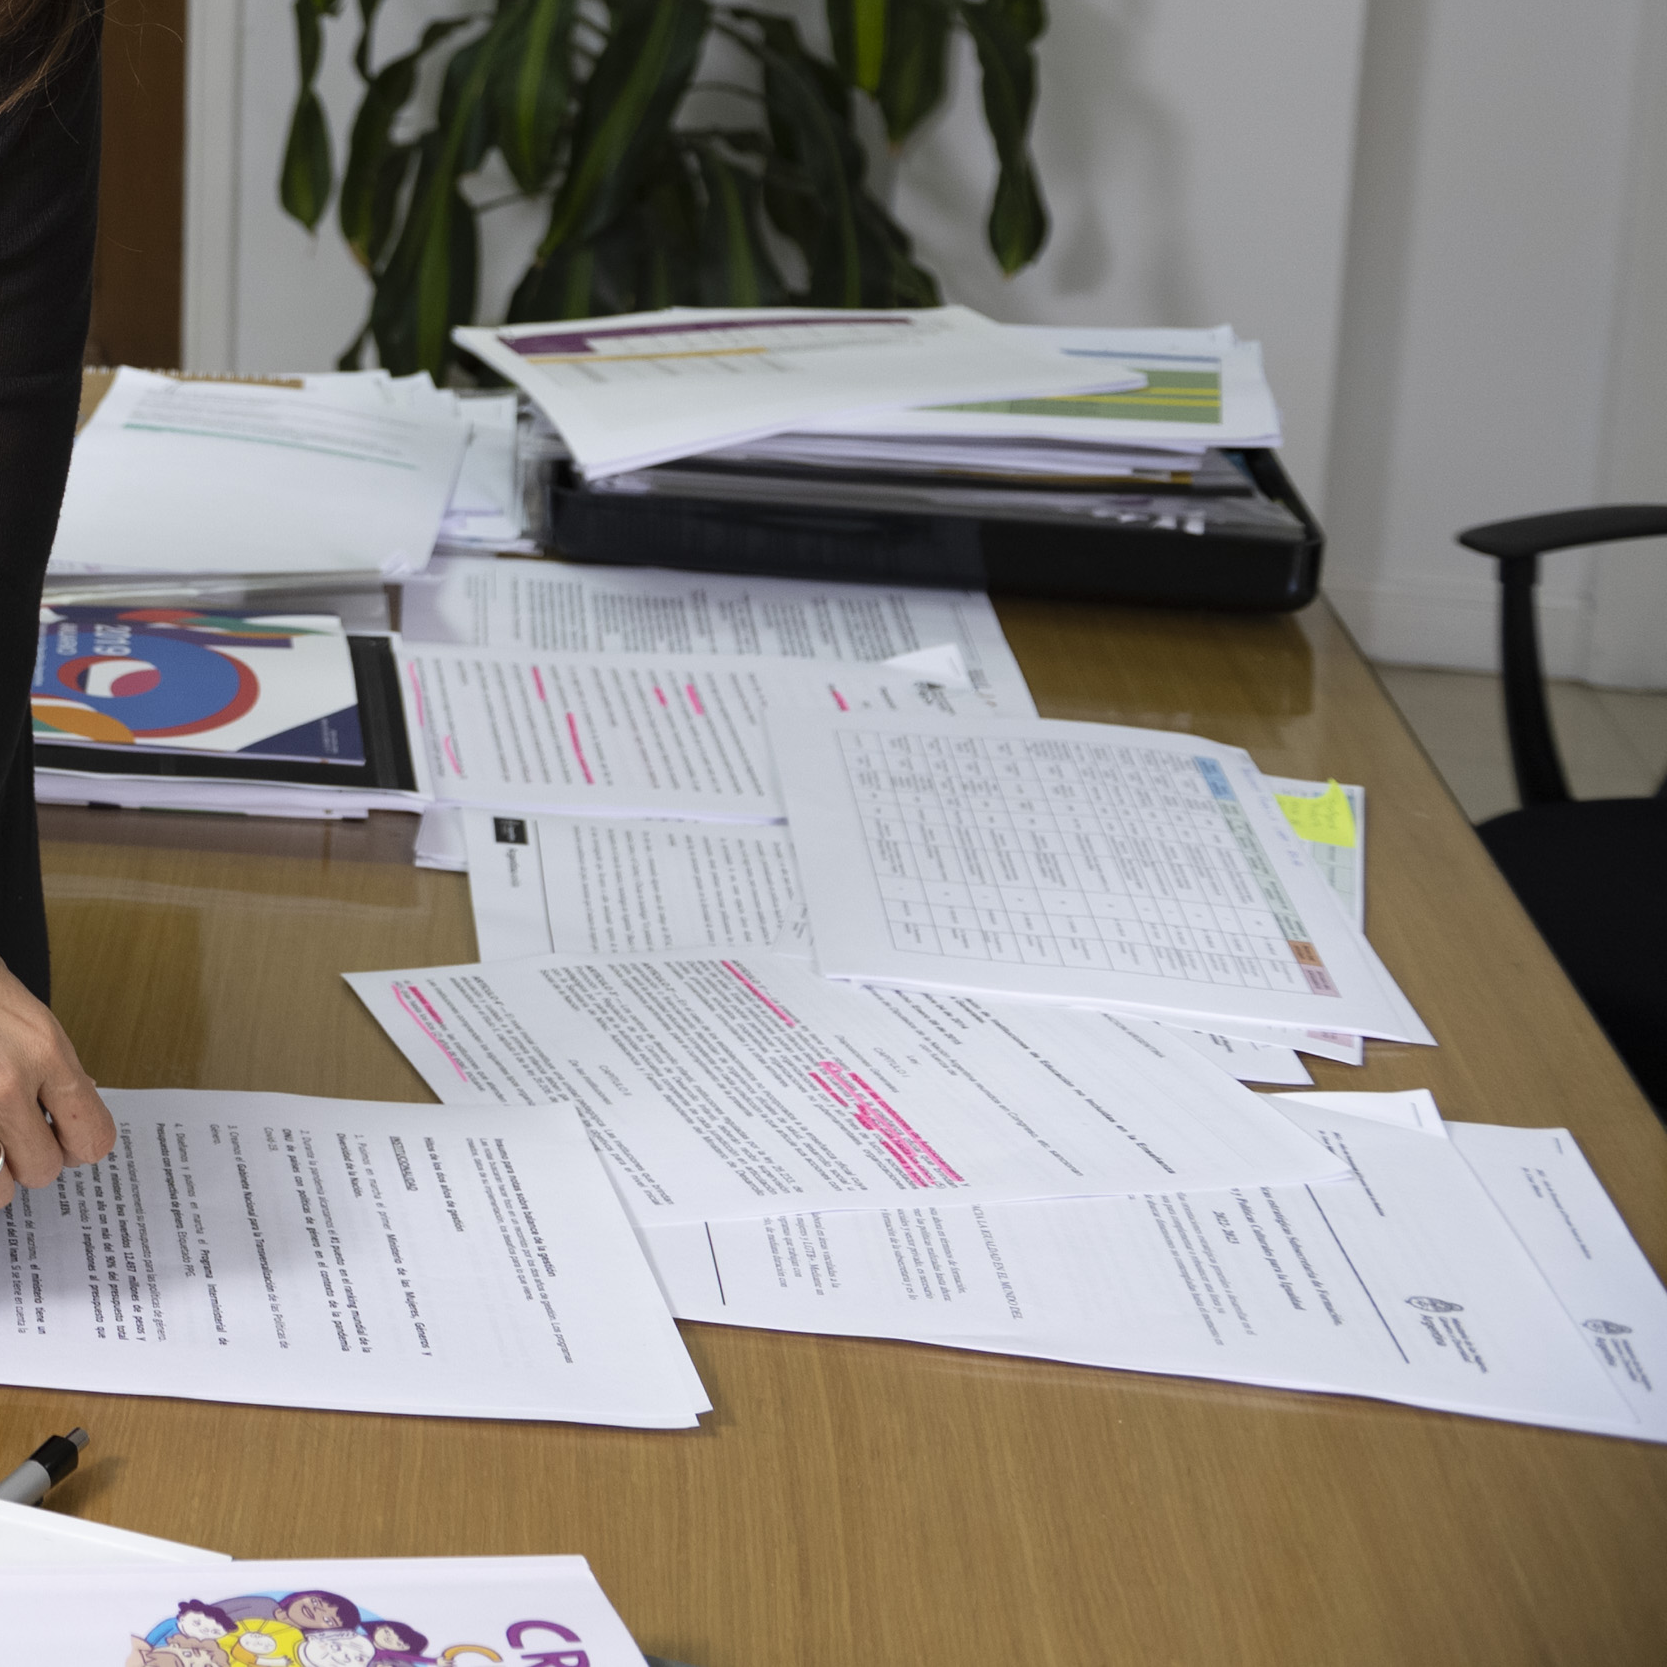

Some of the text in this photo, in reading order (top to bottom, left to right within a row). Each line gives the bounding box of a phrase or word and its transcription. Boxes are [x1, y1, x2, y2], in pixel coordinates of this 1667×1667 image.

[92, 623, 131, 656] 2019
[156, 1122, 170, 1157] Presupuesto
[209, 1123, 221, 1145] Género.
[229, 1131, 241, 1155] Creamos
[282, 1128, 293, 1142] ONU
[424, 1137, 436, 1153] Hitos
[358, 1142, 370, 1165] Pusimos
[494, 1138, 509, 1160] Insumo
[162, 1156, 172, 1168] con
[287, 1154, 301, 1173] países
[336, 1132, 353, 1162] Diversidad
[350, 1177, 363, 1197] Nación.
[389, 1136, 418, 1192] INSTITUCIONALIDAD
[432, 1161, 442, 1171] los
[501, 1160, 515, 1174] para
[162, 1168, 178, 1201] perspectiva
[236, 1163, 250, 1190] Gabinete
[294, 1175, 304, 1187] con
[435, 1171, 447, 1184] dos
[509, 1175, 522, 1192] notas
[93, 1185, 104, 1198] este
[369, 1178, 382, 1200] marcha
[439, 1184, 452, 1199] años
[96, 1200, 108, 1212] año
[243, 1191, 258, 1218] Nacional
[296, 1189, 312, 1214] políticas
[515, 1192, 529, 1210] sobre
[98, 1213, 108, 1225] con
[170, 1208, 184, 1229] género.
[247, 1217, 260, 1231] para
[377, 1211, 392, 1231] primer
[446, 1209, 464, 1232] gestión
[522, 1211, 540, 1236] balance
[101, 1227, 113, 1240] más
[175, 1132, 189, 1163] Diseñamos
[182, 1174, 196, 1198] pusimos
[193, 1213, 204, 1235] marcha
[199, 1249, 214, 1279] Programa
[207, 1283, 227, 1333] Interministerial
[301, 1136, 315, 1159] Durante
[309, 1167, 325, 1195] pandemia
[318, 1196, 334, 1229] alcanzamos
[330, 1244, 345, 1266] puesto
[344, 1285, 358, 1310] ranking
[351, 1310, 368, 1336] mundial
[305, 1226, 321, 1248] género
[103, 1242, 115, 1253] del
[177, 1231, 191, 1264] Etiquetado
[386, 1233, 403, 1264] Ministerio
[105, 1255, 117, 1269] 90%
[184, 1264, 196, 1277] PPG.
[254, 1238, 275, 1293] Transversalización
[536, 1252, 556, 1278] gestión
[107, 1271, 120, 1282] del
[319, 1270, 335, 1297] contexto
[400, 1279, 411, 1288] las
[107, 1283, 124, 1322] presupuesto
[270, 1303, 279, 1312] las
[404, 1291, 420, 1319] Mujeres,
[116, 1325, 128, 1341] total
[273, 1314, 286, 1339] Políticas
[332, 1320, 350, 1352] pandemia
[414, 1322, 430, 1349] Géneros
